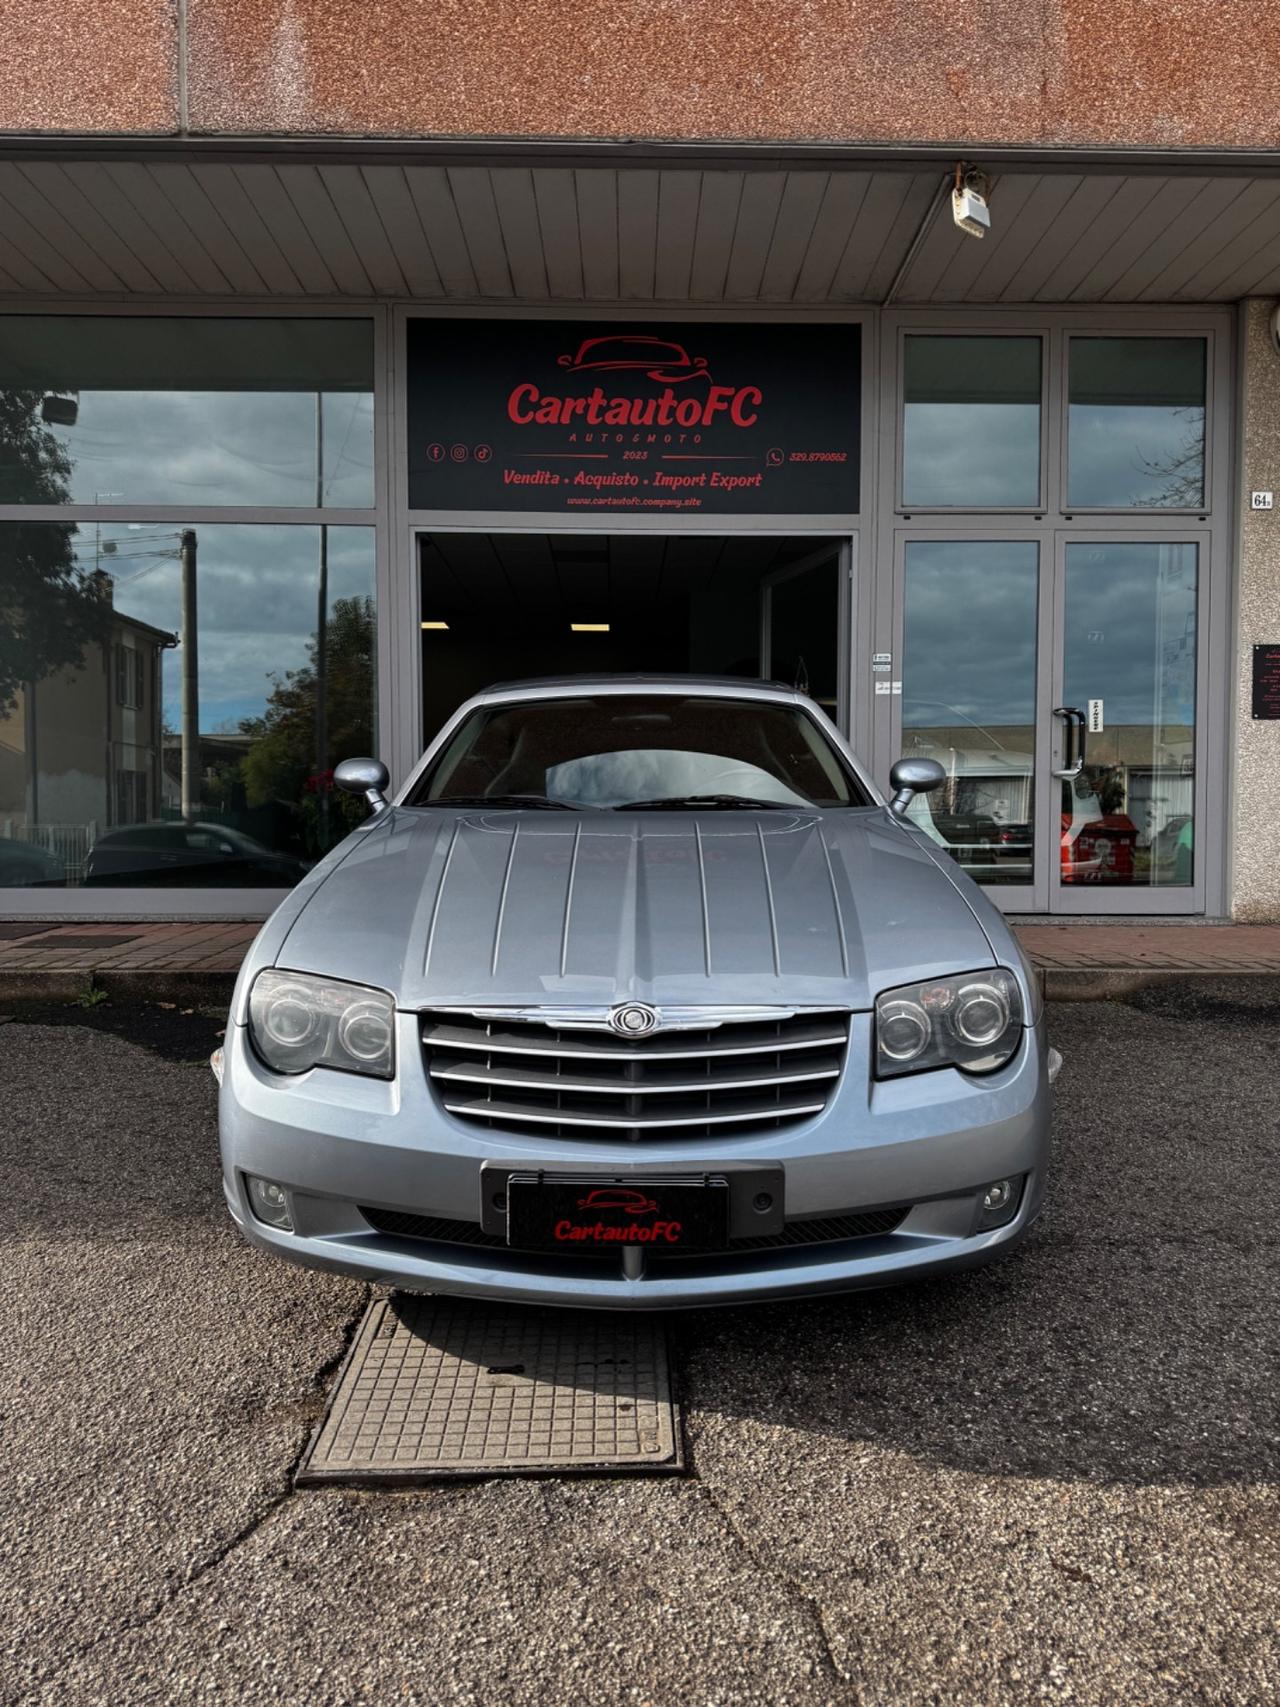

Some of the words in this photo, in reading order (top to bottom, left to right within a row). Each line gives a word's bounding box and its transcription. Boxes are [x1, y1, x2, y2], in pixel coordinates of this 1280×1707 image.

[507, 383, 762, 427] CartautoFC
[503, 469, 560, 486] Vendita
[573, 471, 639, 490] Acquisto
[653, 471, 707, 491] Import
[709, 472, 763, 490] Export
[554, 1220, 681, 1242] CartautoFC
